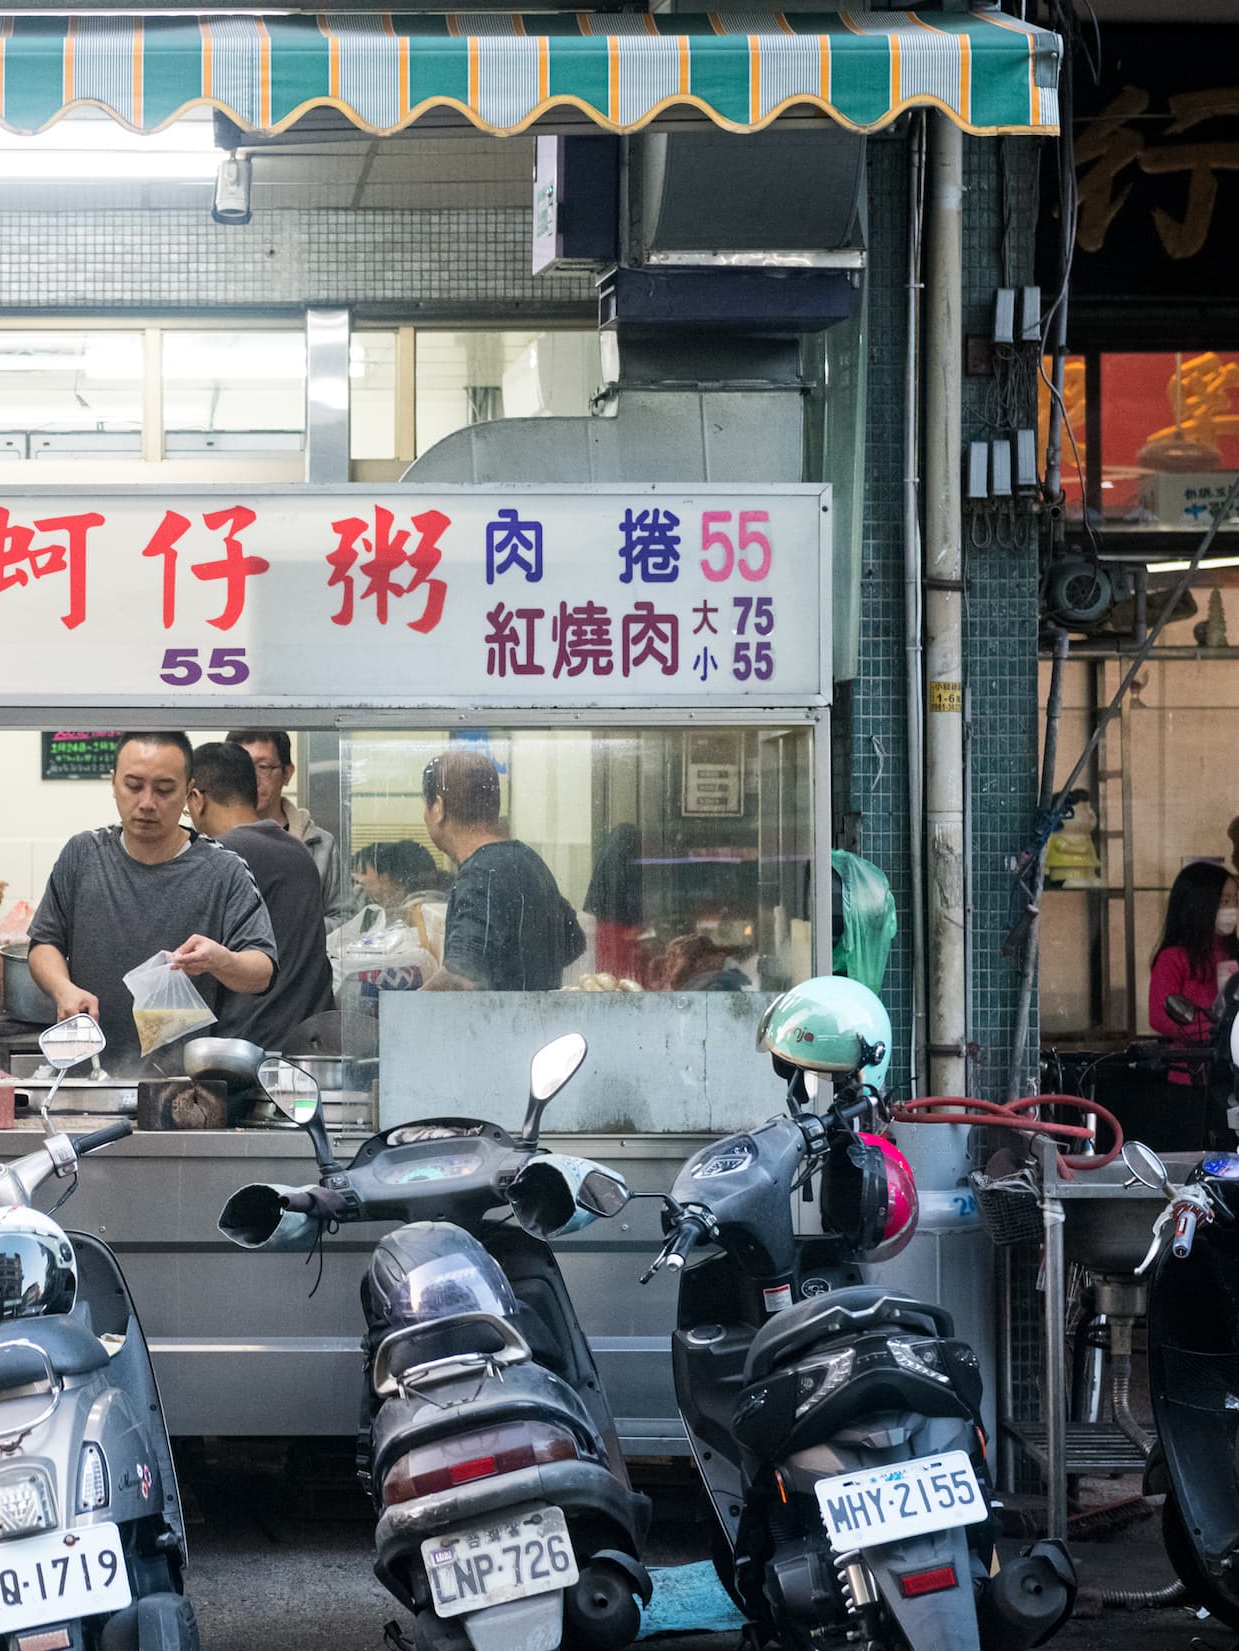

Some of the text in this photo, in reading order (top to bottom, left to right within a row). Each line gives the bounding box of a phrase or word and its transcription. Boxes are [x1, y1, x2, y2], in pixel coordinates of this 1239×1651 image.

[700, 511, 772, 582] 55
[485, 597, 775, 679] 紅燒肉 大 75
[693, 642, 775, 681] 小 55
[160, 648, 251, 686] 55
